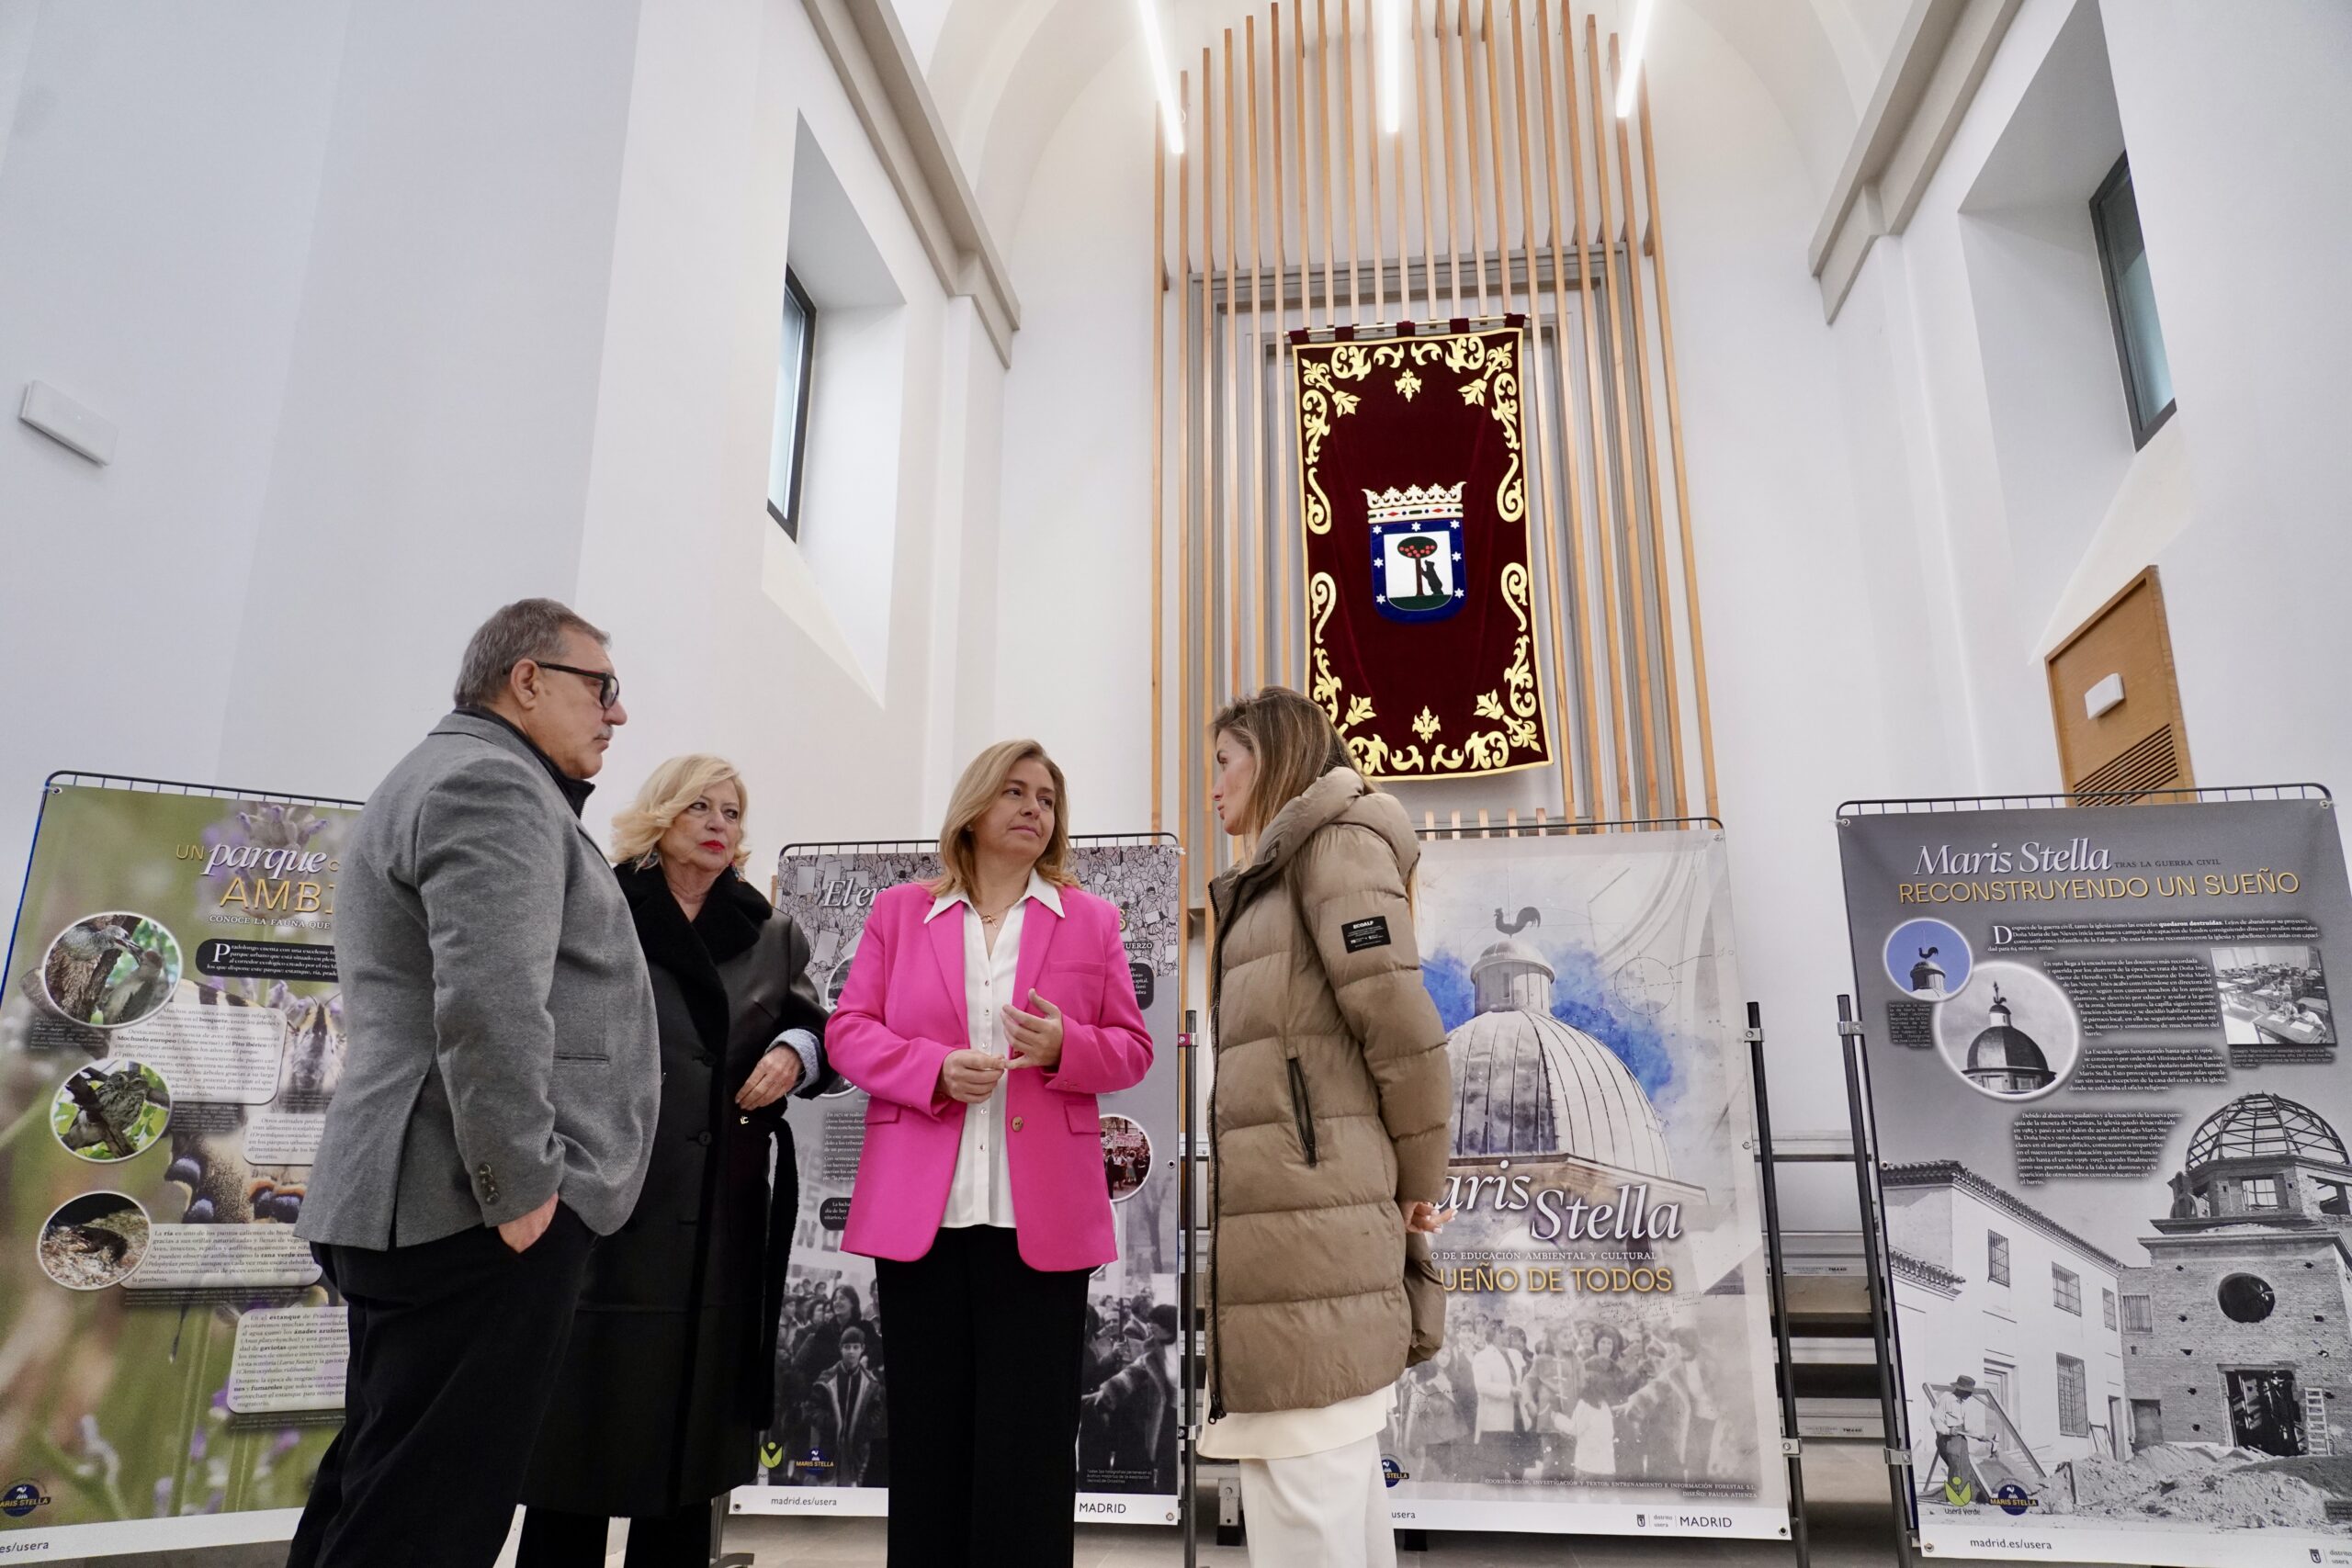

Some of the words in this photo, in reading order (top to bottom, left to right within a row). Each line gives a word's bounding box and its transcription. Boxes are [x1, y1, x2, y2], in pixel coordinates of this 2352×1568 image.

[176, 844, 205, 862] UN
[200, 842, 329, 881] parque
[1914, 842, 2013, 875] Maris
[2020, 838, 2111, 873] Stella
[2114, 861, 2137, 869] TRAS
[822, 877, 854, 907] El
[1899, 877, 2150, 904] RECONSTRUYENDO
[2156, 875, 2197, 897] UN
[2204, 867, 2300, 897] SUEÑO
[209, 915, 251, 925] CONOCE
[270, 919, 305, 929] FAUNA
[309, 921, 331, 930] QUE
[1434, 1159, 1532, 1211] aris
[1531, 1183, 1682, 1240] Stella
[1442, 1252, 1456, 1260] DE
[1461, 1250, 1521, 1260] EDUCACIÓN
[1525, 1252, 1586, 1260] AMBIENTAL
[1600, 1252, 1657, 1260] CULTURAL
[1441, 1262, 1519, 1292] UEÑO
[1527, 1268, 1564, 1292] DE
[1572, 1268, 1673, 1292] TODOS
[771, 1496, 838, 1506] madrid.es/usera
[2012, 1498, 2037, 1506] STELLA
[1079, 1502, 1126, 1514] MADRID
[1679, 1516, 1733, 1528] MADRID
[1970, 1538, 2052, 1550] madrid.es/usera
